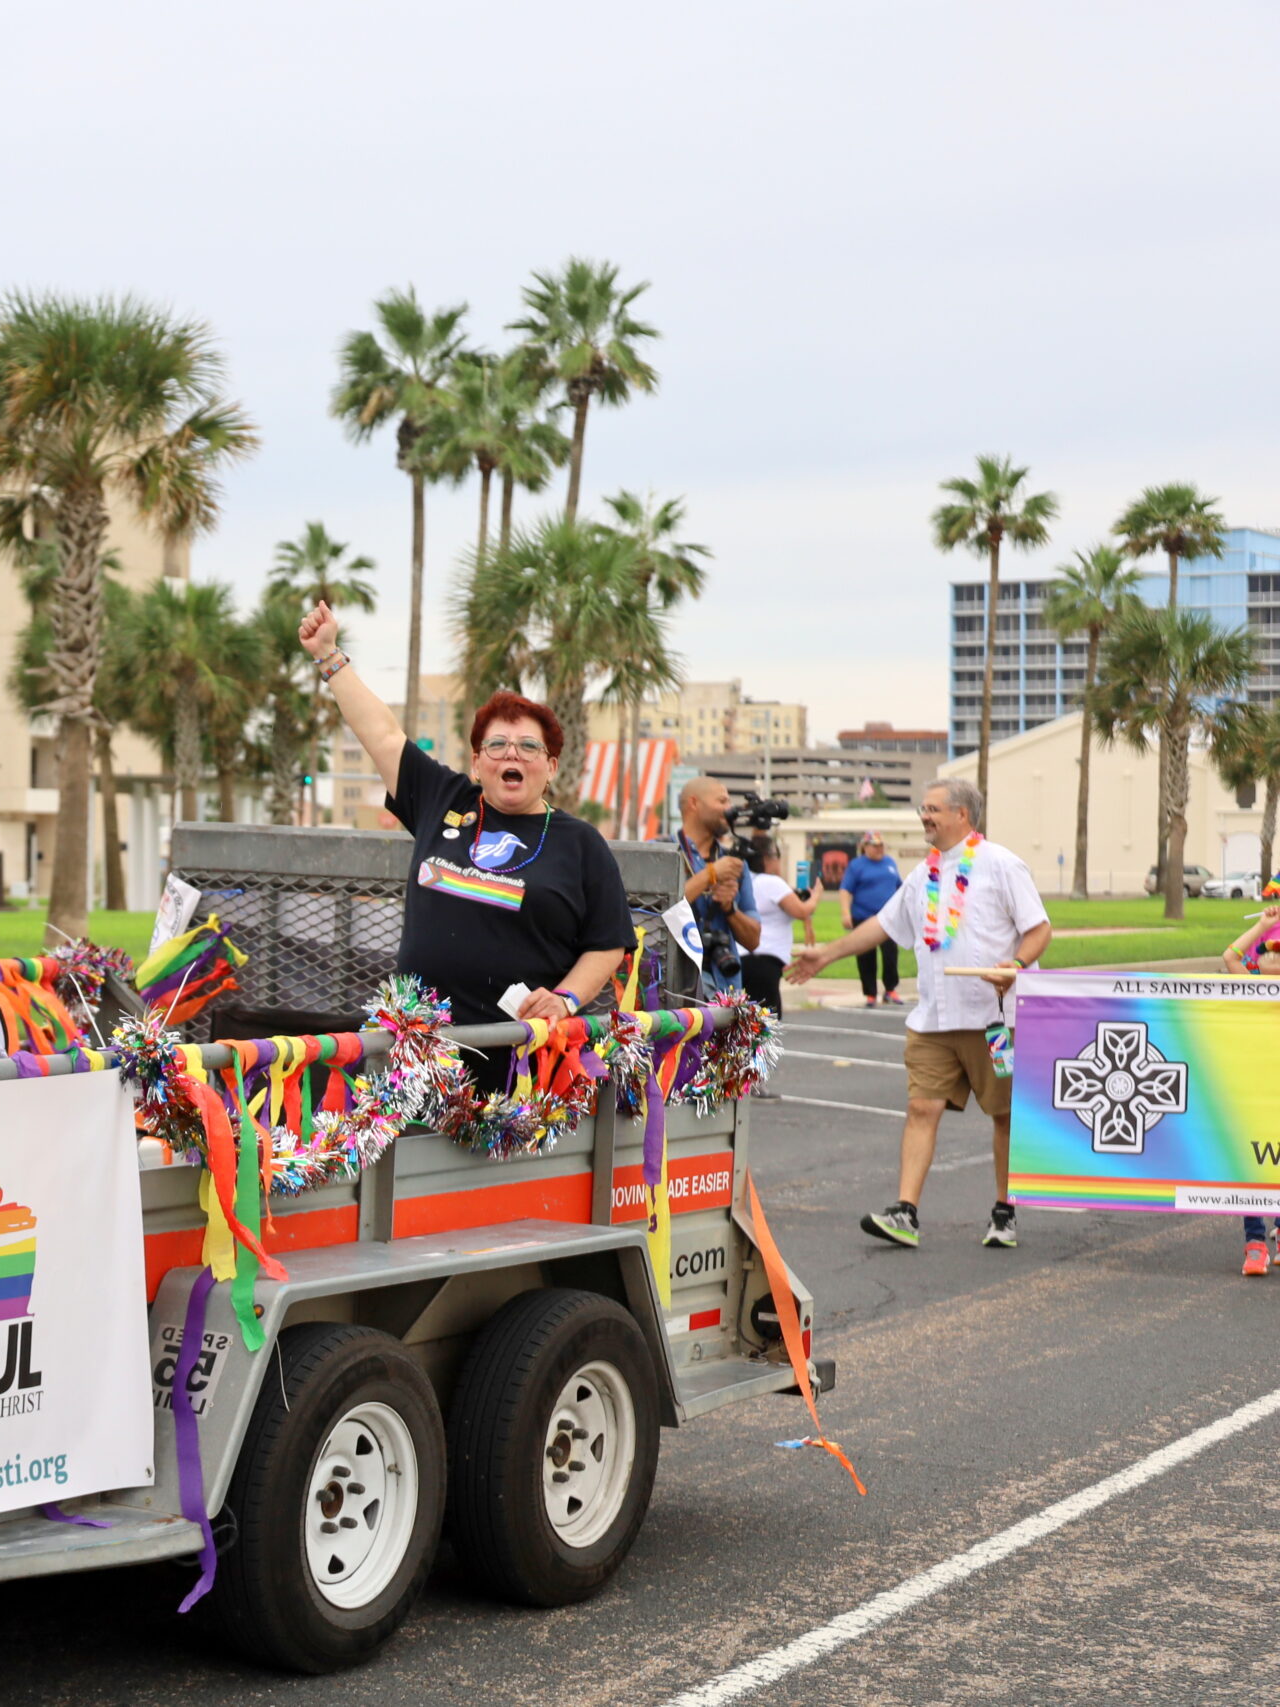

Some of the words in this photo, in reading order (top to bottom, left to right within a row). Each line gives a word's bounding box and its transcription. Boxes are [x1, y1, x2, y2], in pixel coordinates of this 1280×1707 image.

[436, 857, 462, 874] Union
[463, 867, 473, 877] of
[472, 868, 525, 888] Professionals
[1113, 980, 1144, 994] ALL
[1150, 981, 1215, 995] SAINTS'
[612, 1184, 645, 1208] OVIN
[667, 1177, 689, 1199] ADE
[691, 1171, 730, 1195] EASIER
